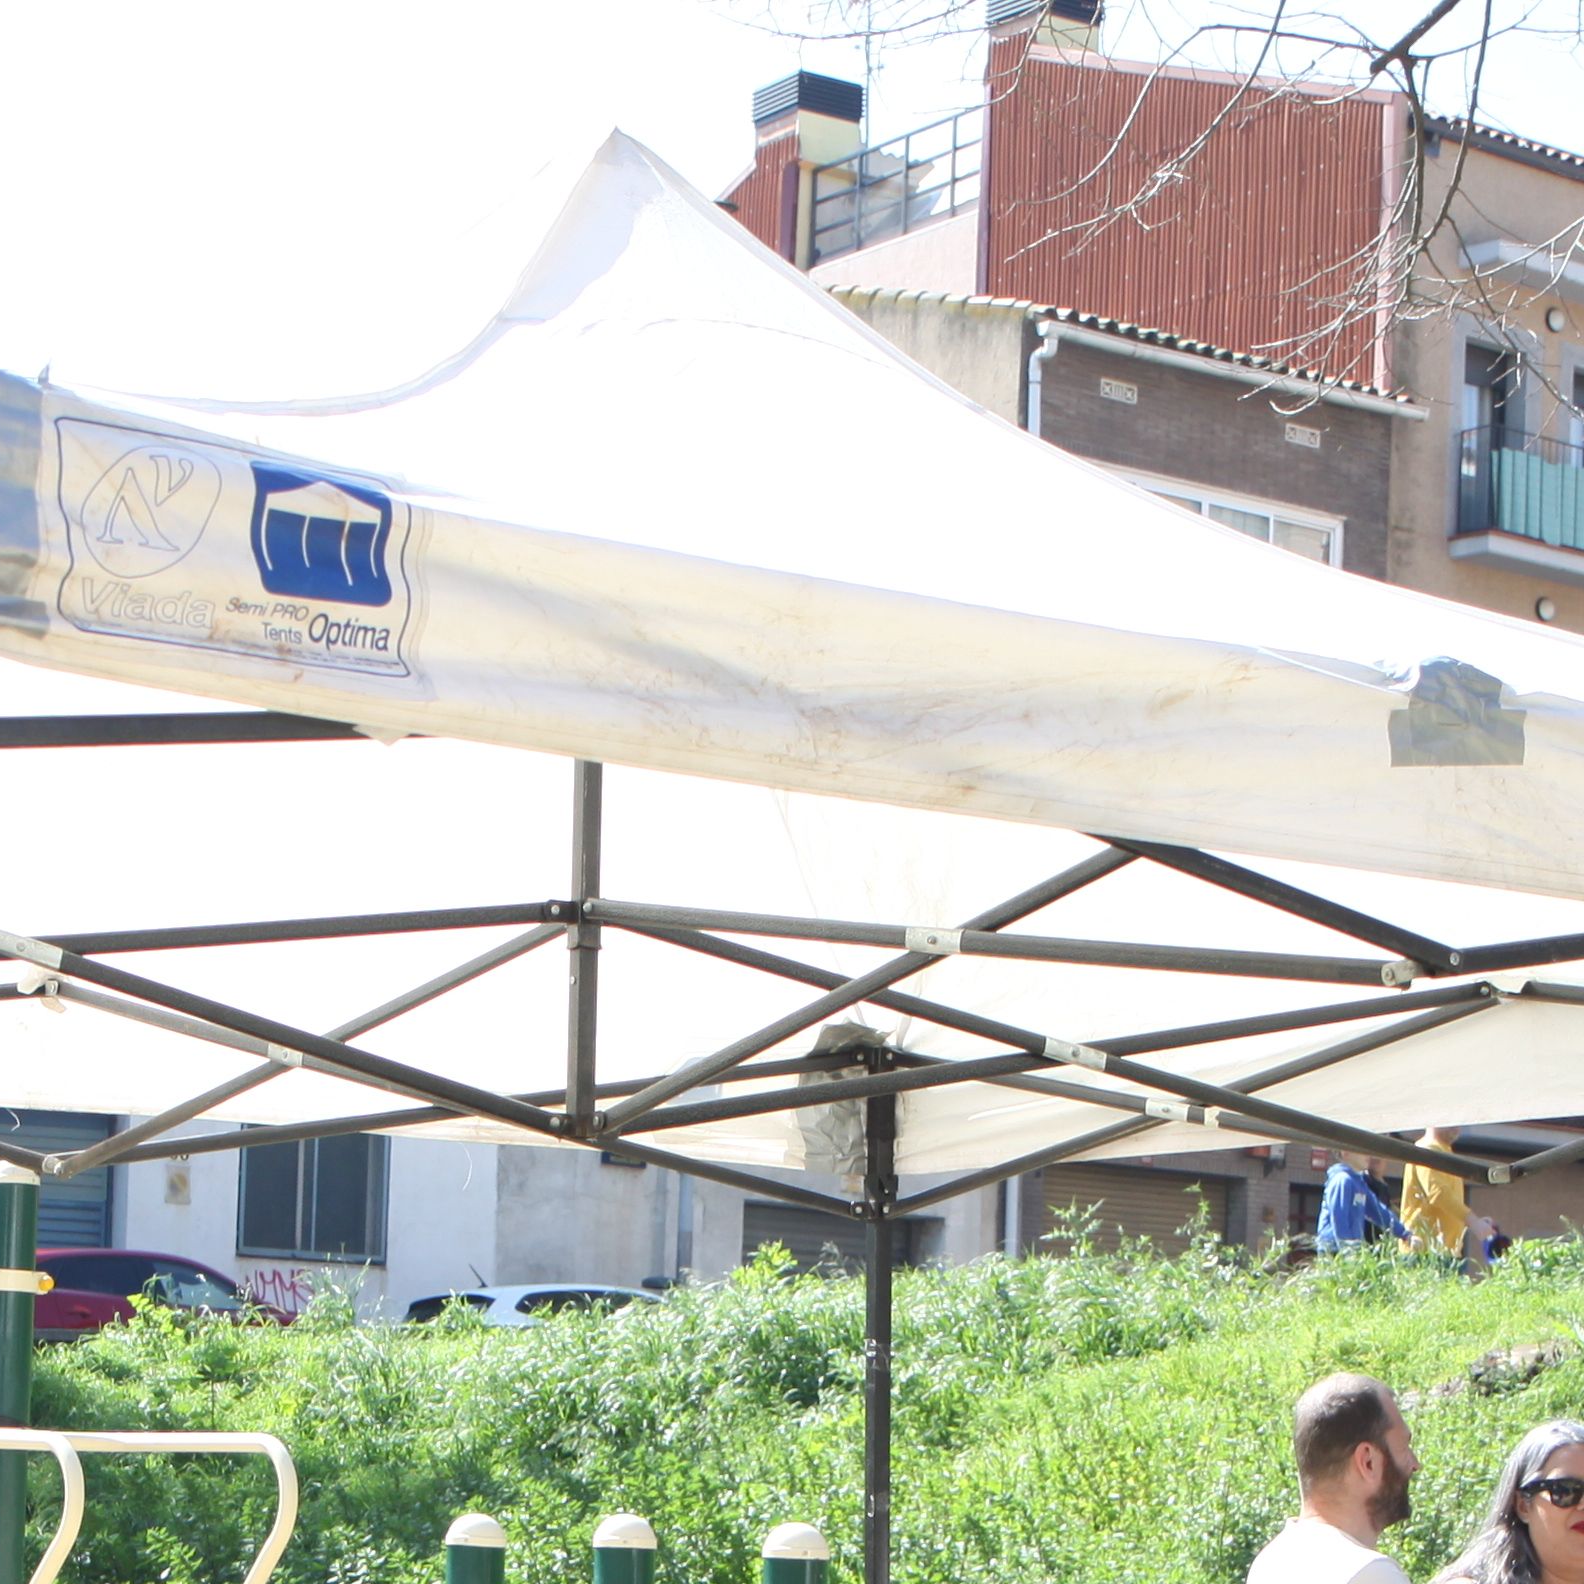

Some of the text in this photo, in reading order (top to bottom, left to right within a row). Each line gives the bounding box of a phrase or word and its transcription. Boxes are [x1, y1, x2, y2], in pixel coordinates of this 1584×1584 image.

[82, 577, 216, 628] Viada
[225, 597, 310, 622] Semi PRO
[262, 613, 391, 651] Tents Optima
